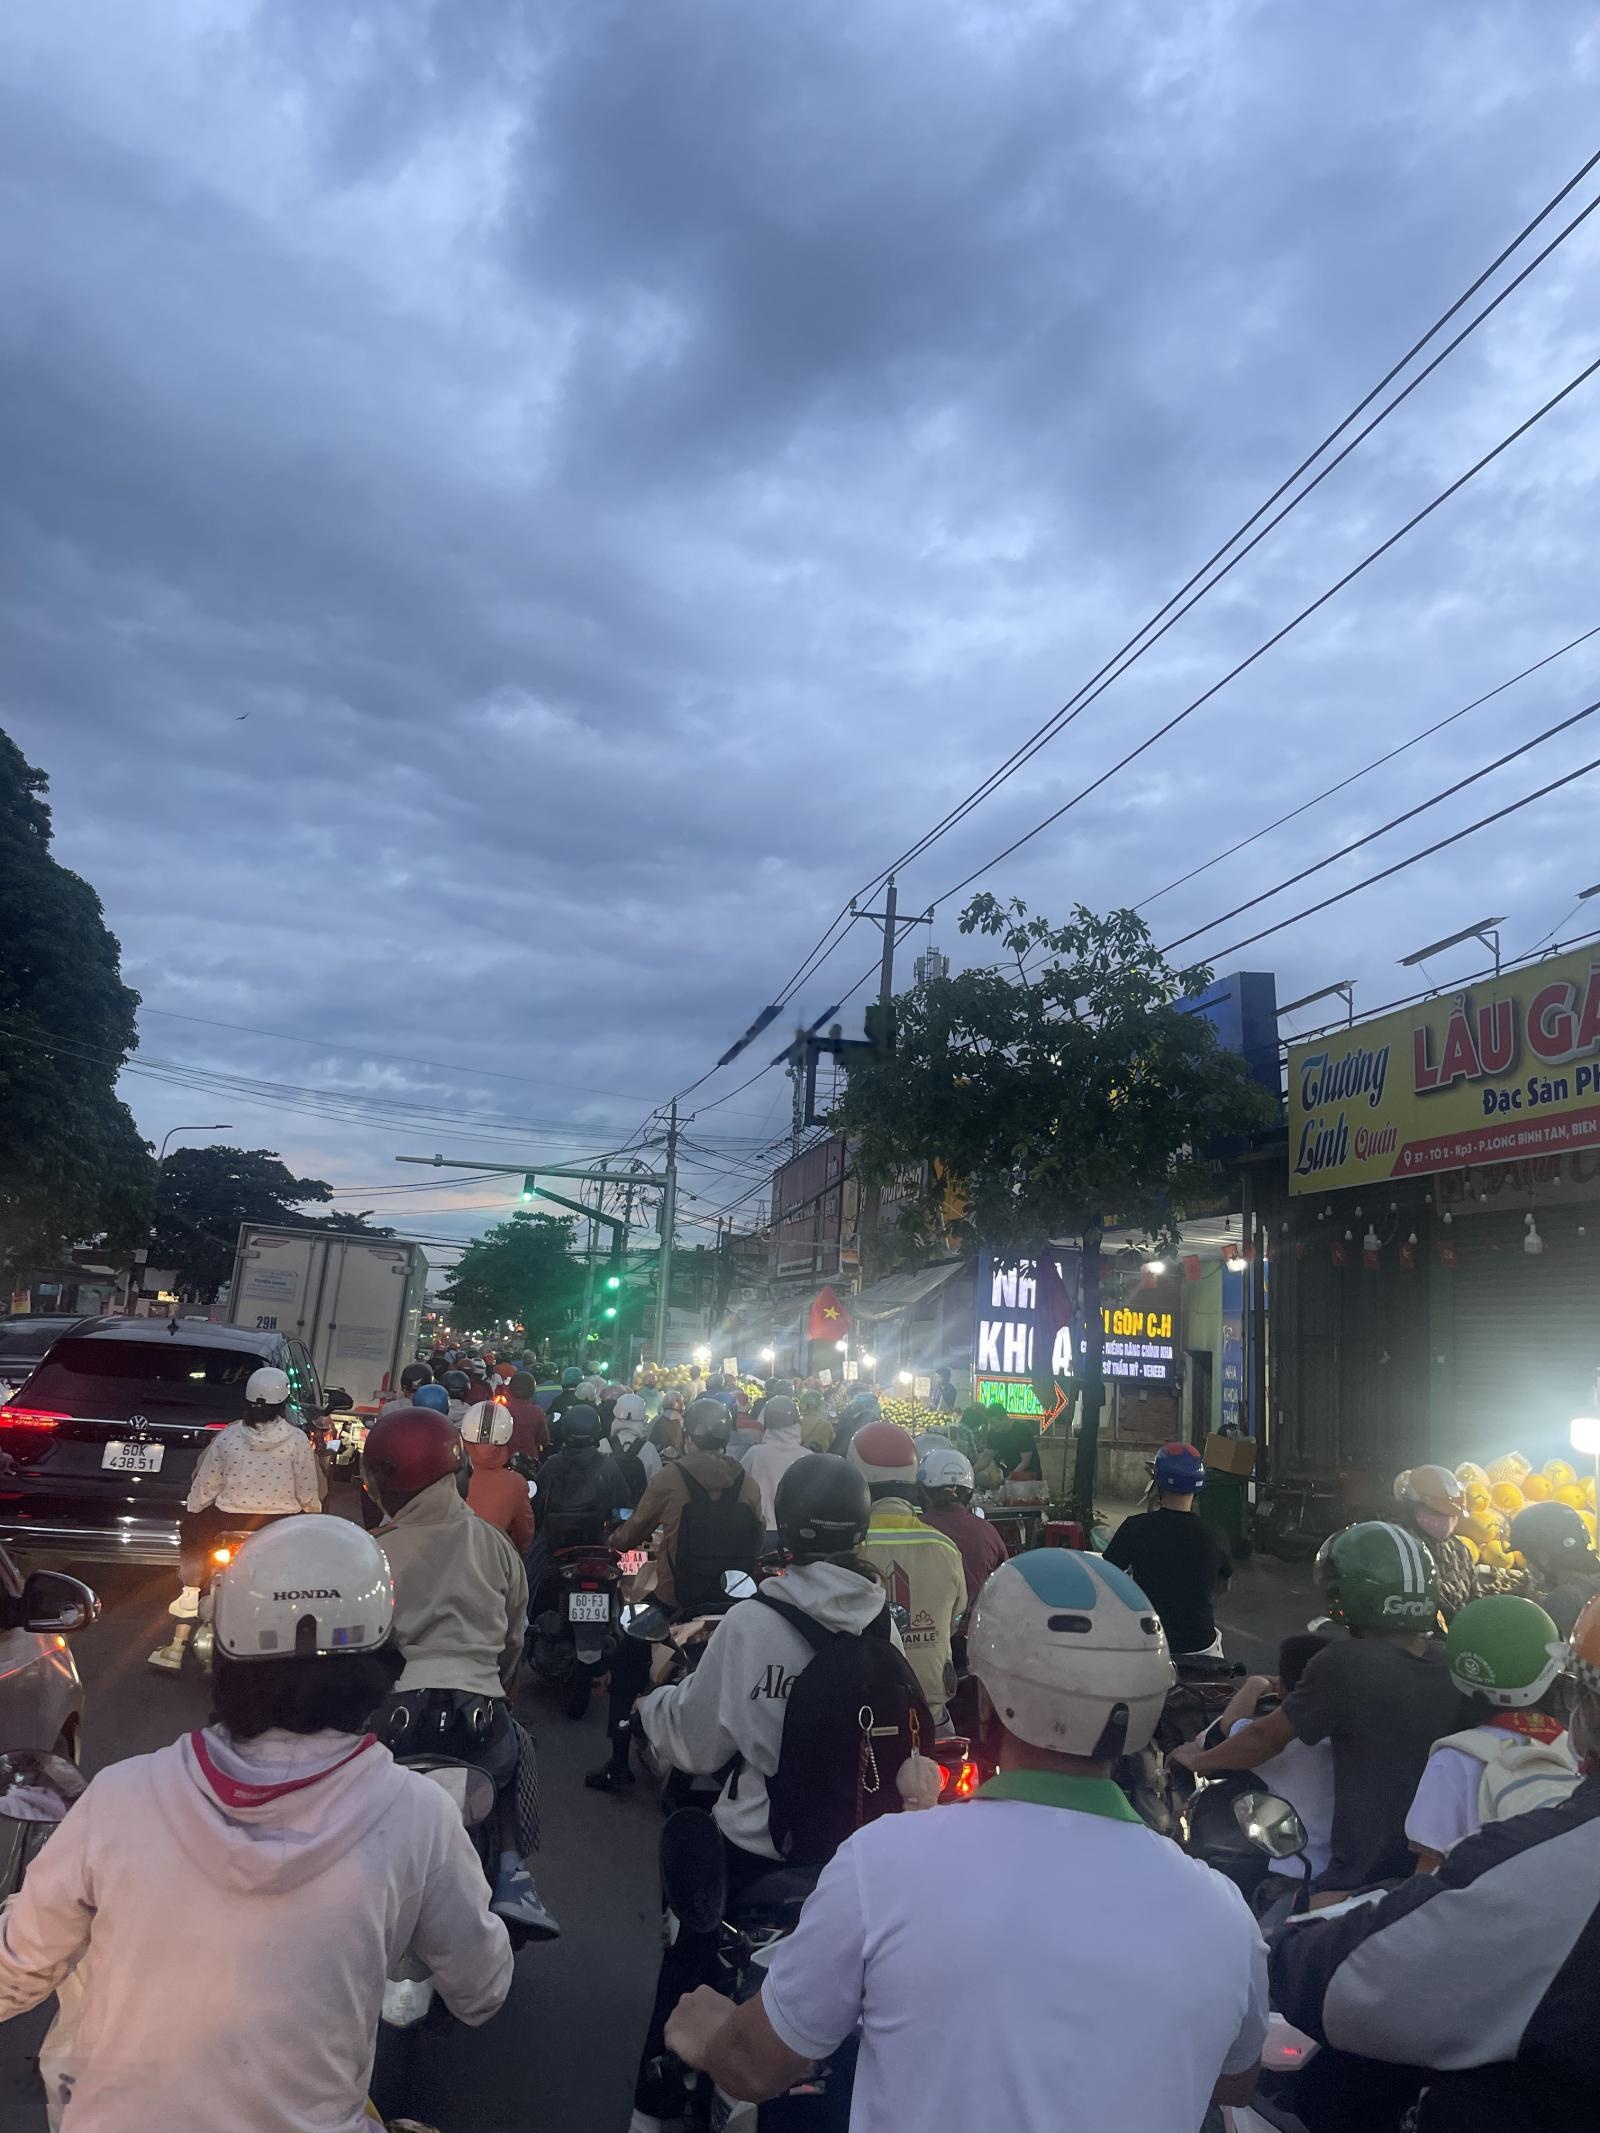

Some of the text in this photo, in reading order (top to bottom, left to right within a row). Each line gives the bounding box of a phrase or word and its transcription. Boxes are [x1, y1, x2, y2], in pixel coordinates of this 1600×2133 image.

[1483, 1088, 1522, 1115] Đặc
[1528, 1076, 1568, 1107] Sản
[1293, 1112, 1398, 1175] Linh Quán
[256, 1315, 277, 1330] 29H
[122, 1444, 148, 1457] 60K
[110, 1457, 154, 1470] 438.51
[273, 1589, 342, 1601] HONDA
[571, 1608, 608, 1621] 632.94
